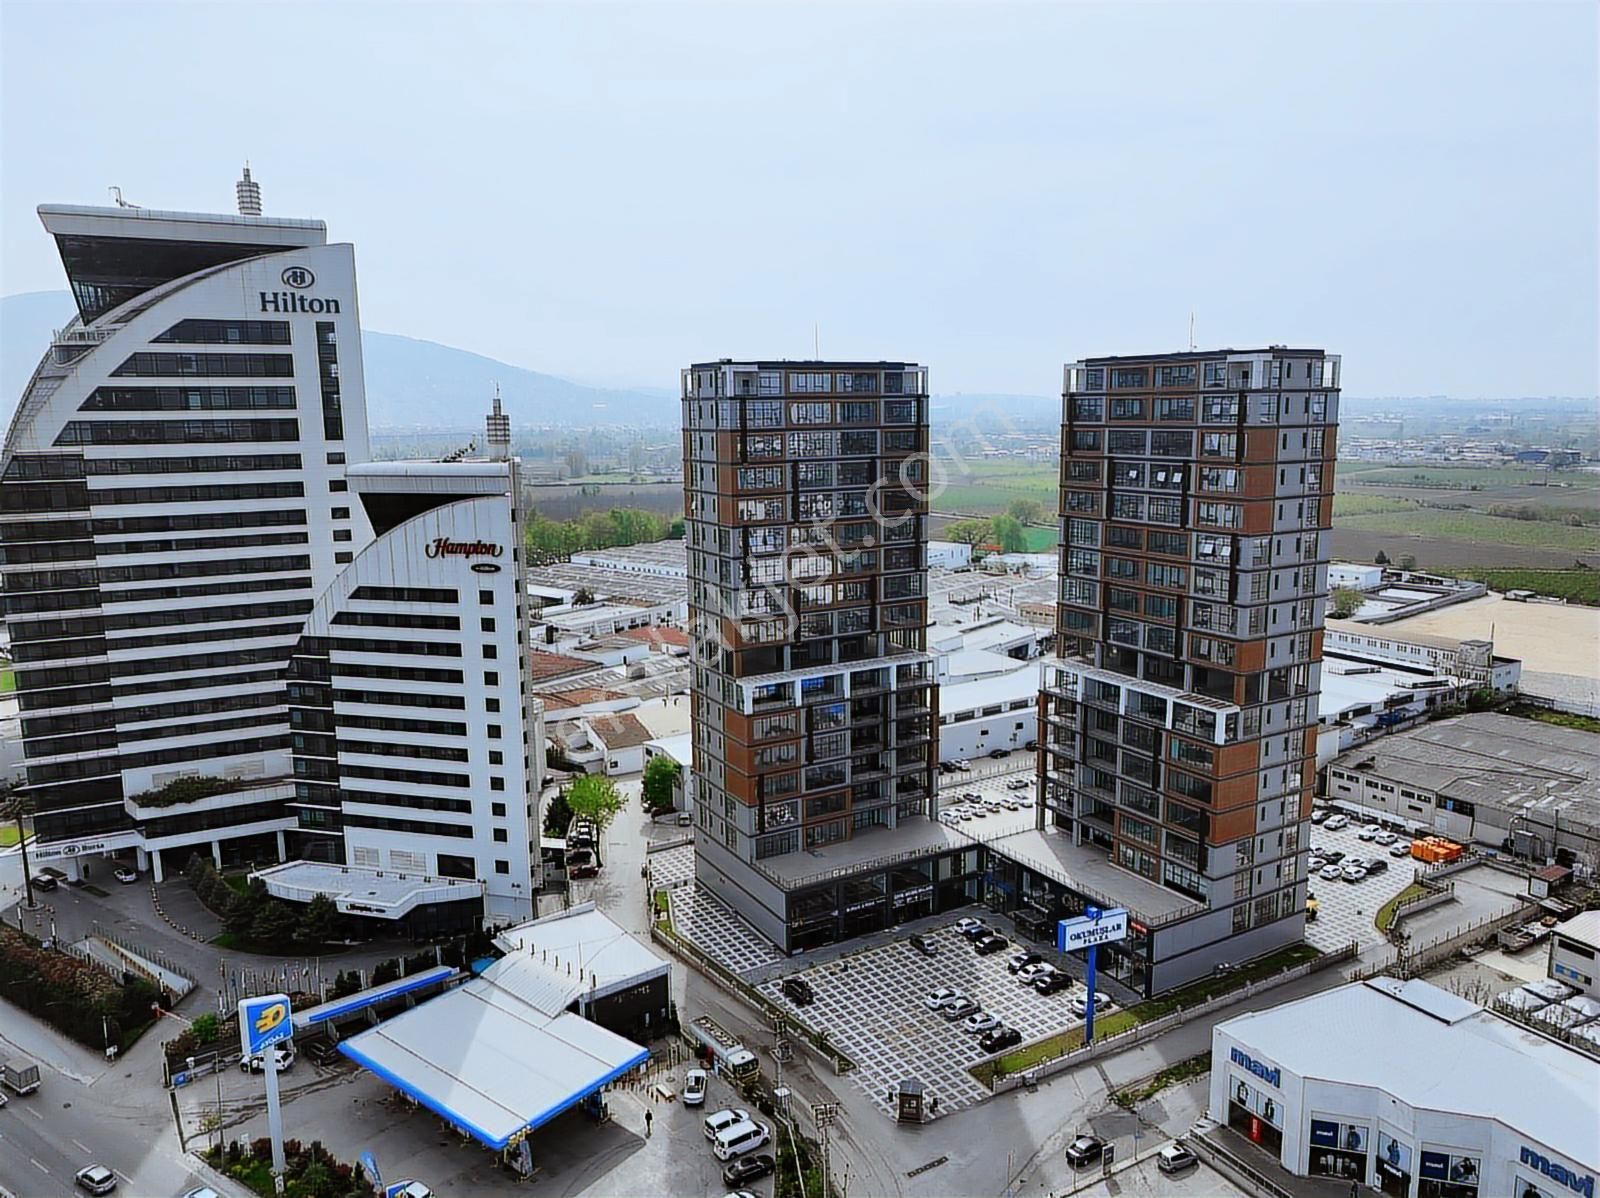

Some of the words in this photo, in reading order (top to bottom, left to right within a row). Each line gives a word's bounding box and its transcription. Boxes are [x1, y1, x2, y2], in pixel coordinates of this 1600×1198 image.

[259, 292, 341, 314] Hilton
[425, 537, 504, 559] Hampton
[1230, 1046, 1282, 1089] mavi
[1520, 1145, 1595, 1198] mavi
